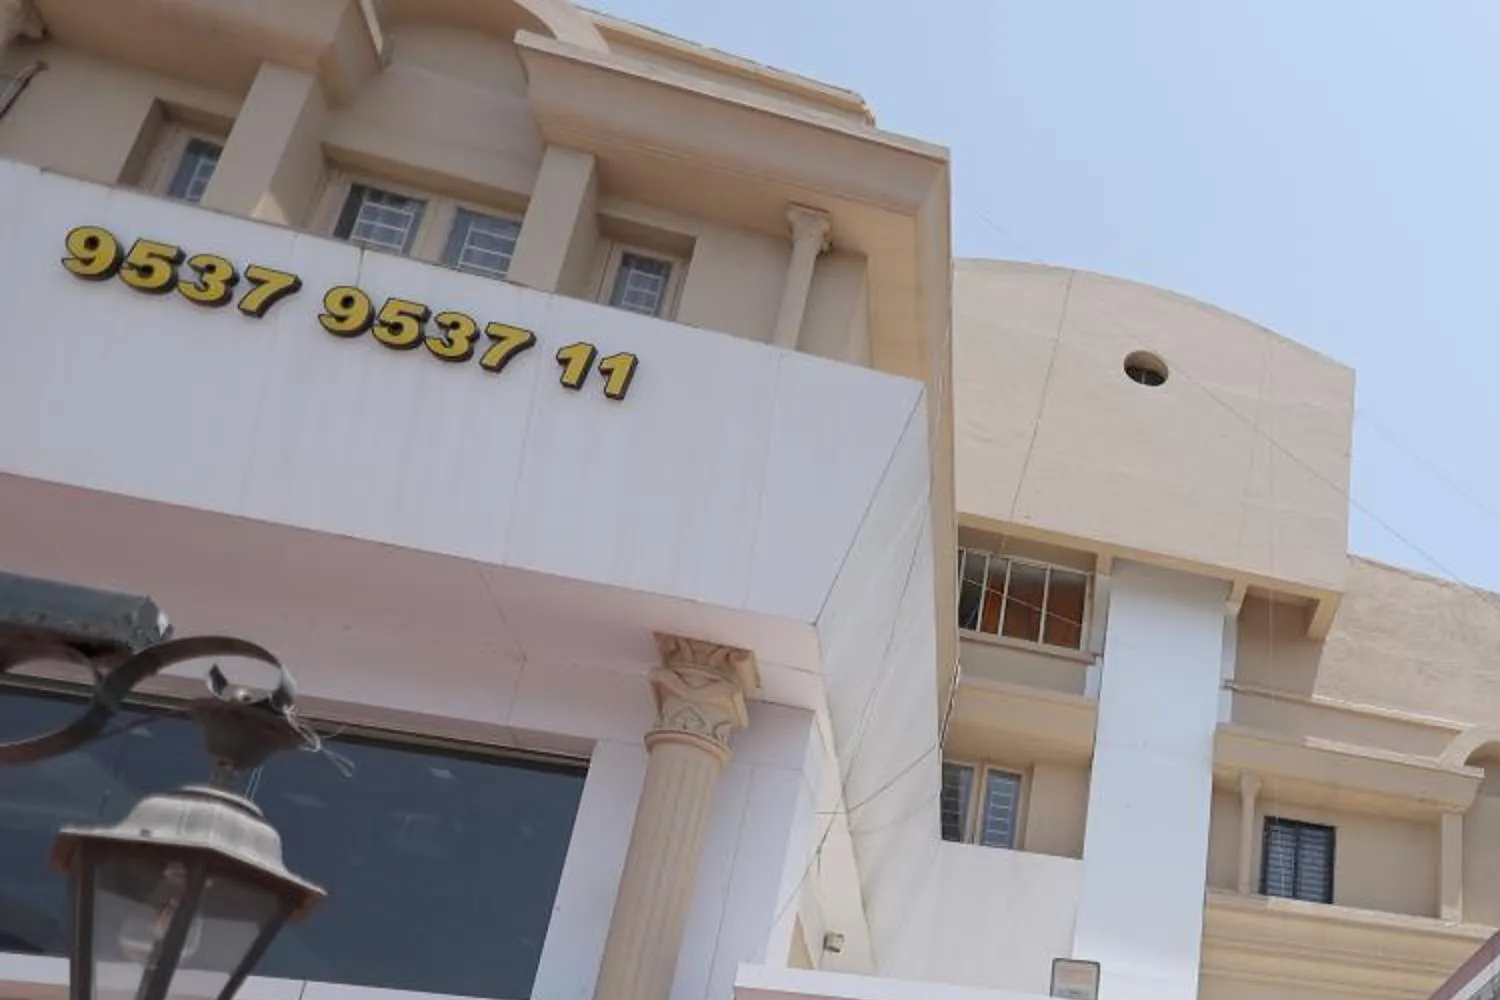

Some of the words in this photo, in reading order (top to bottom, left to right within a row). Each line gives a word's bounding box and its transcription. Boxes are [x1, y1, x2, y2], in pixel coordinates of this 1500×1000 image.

[62, 225, 302, 319] 9537
[318, 285, 536, 373] 9537
[556, 341, 638, 400] 11
